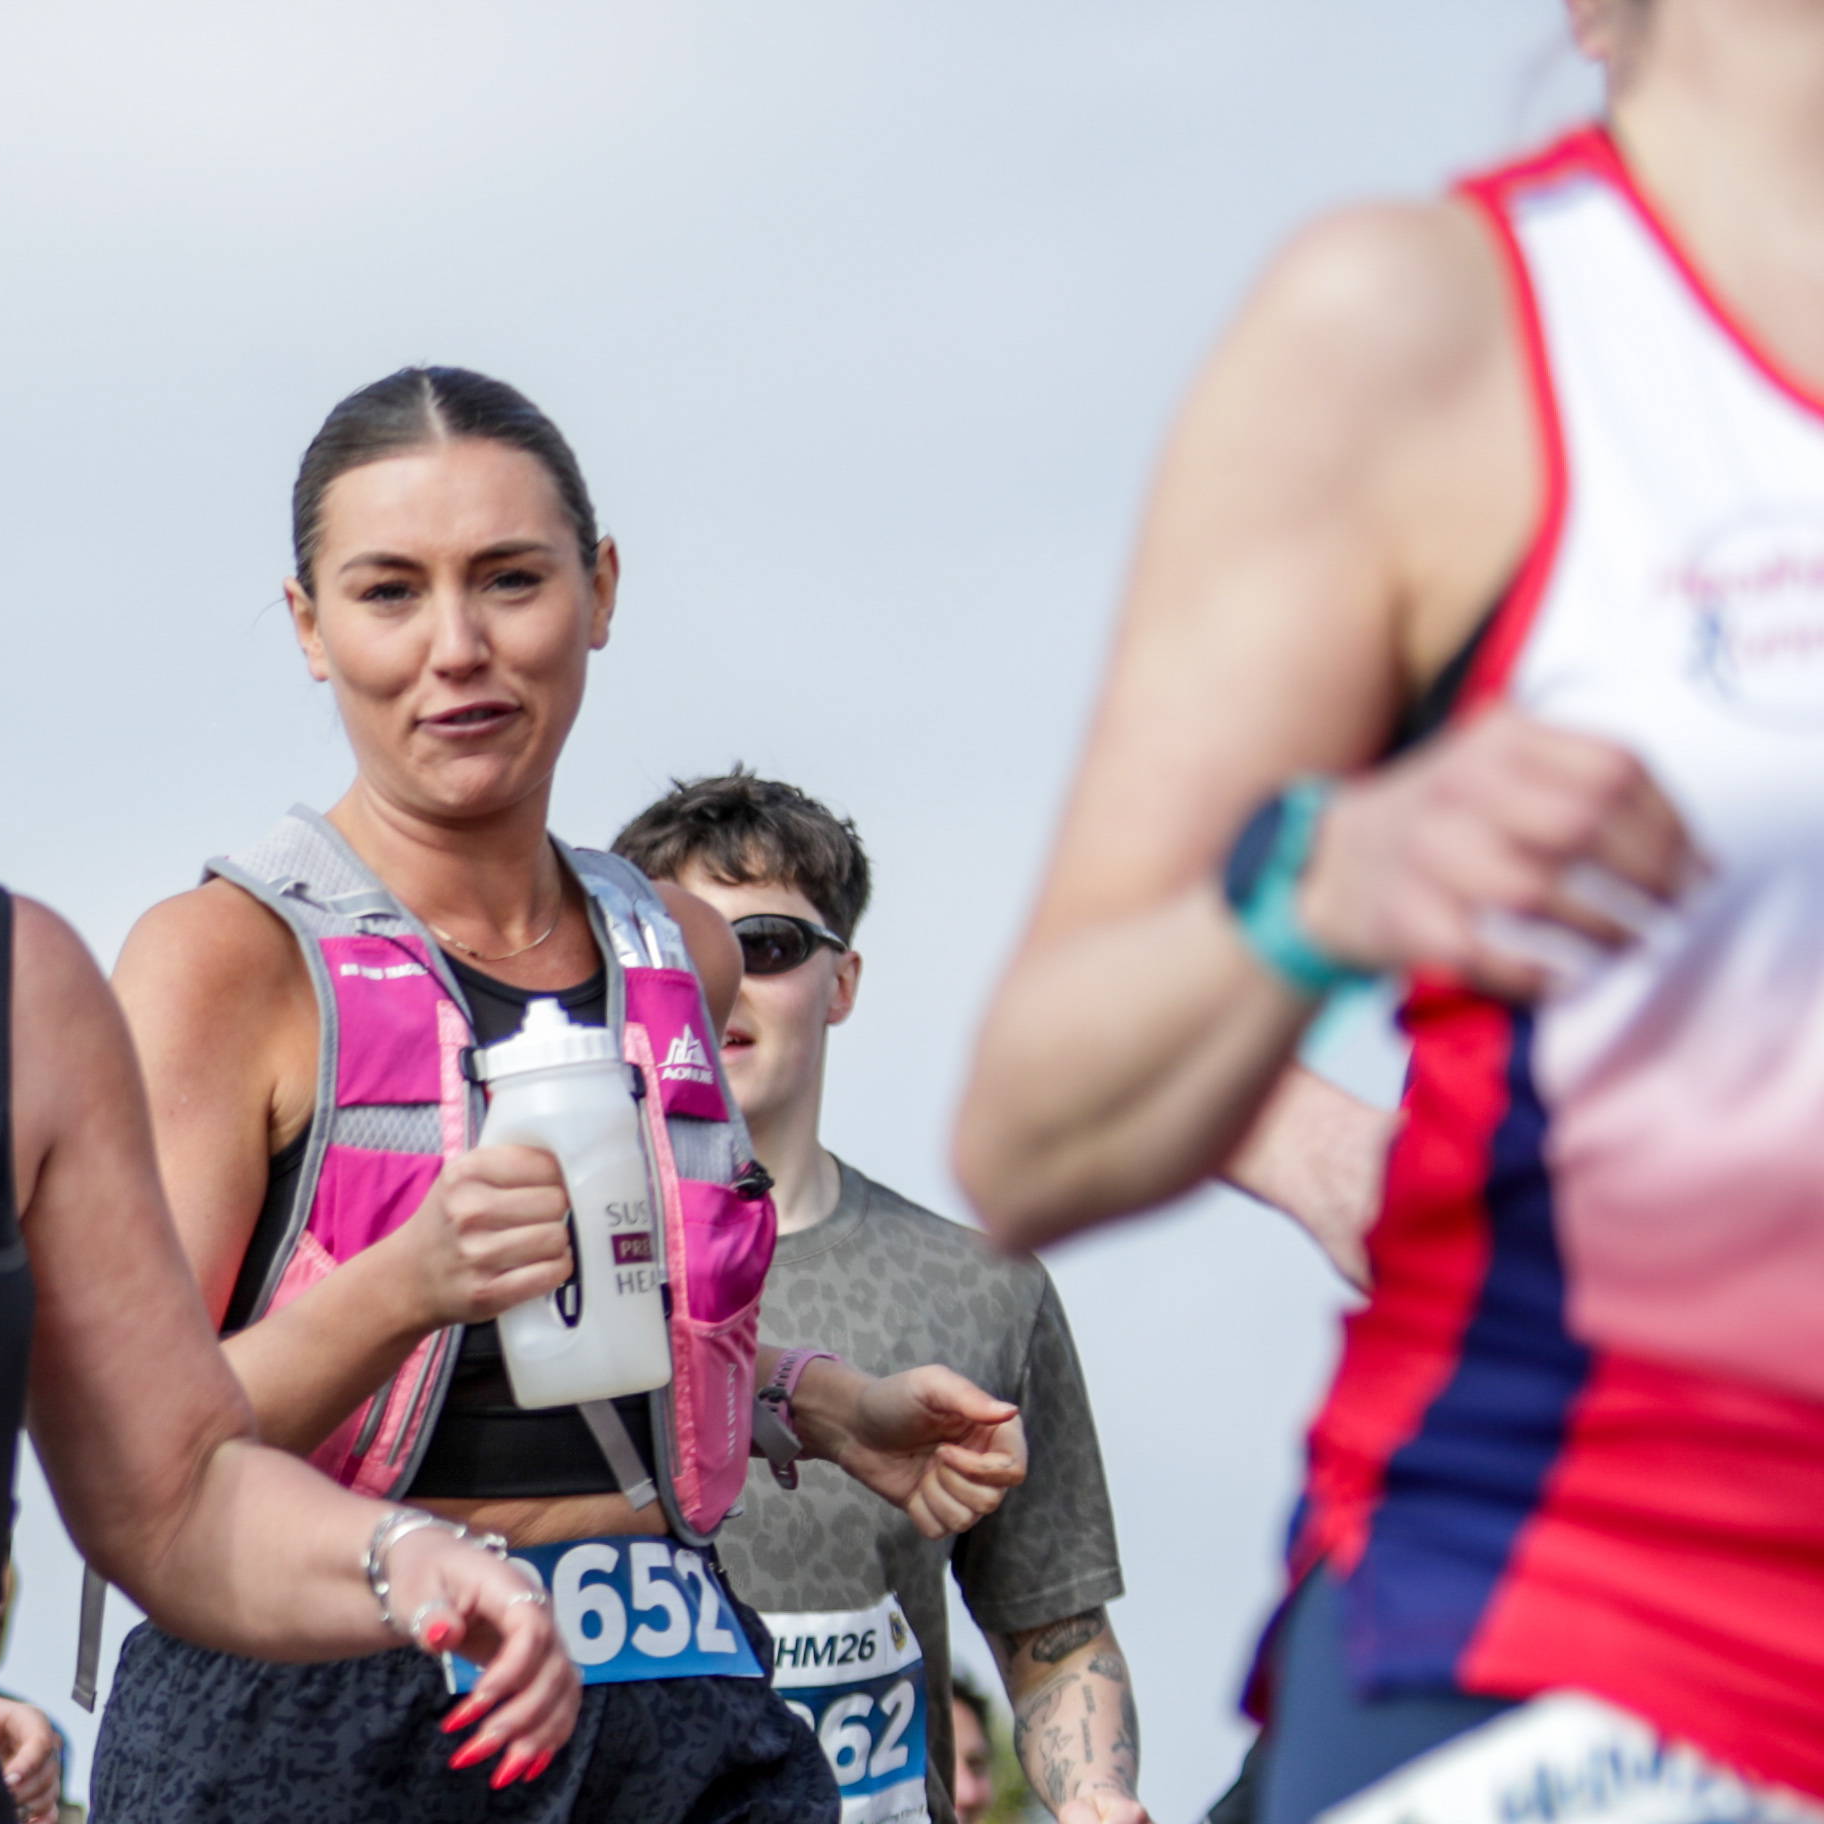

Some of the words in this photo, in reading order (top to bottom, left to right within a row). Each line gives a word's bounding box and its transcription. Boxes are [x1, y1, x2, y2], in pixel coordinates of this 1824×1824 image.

[605, 1201, 650, 1227] SUS
[504, 1542, 738, 1667] 652
[774, 1629, 877, 1669] HM26
